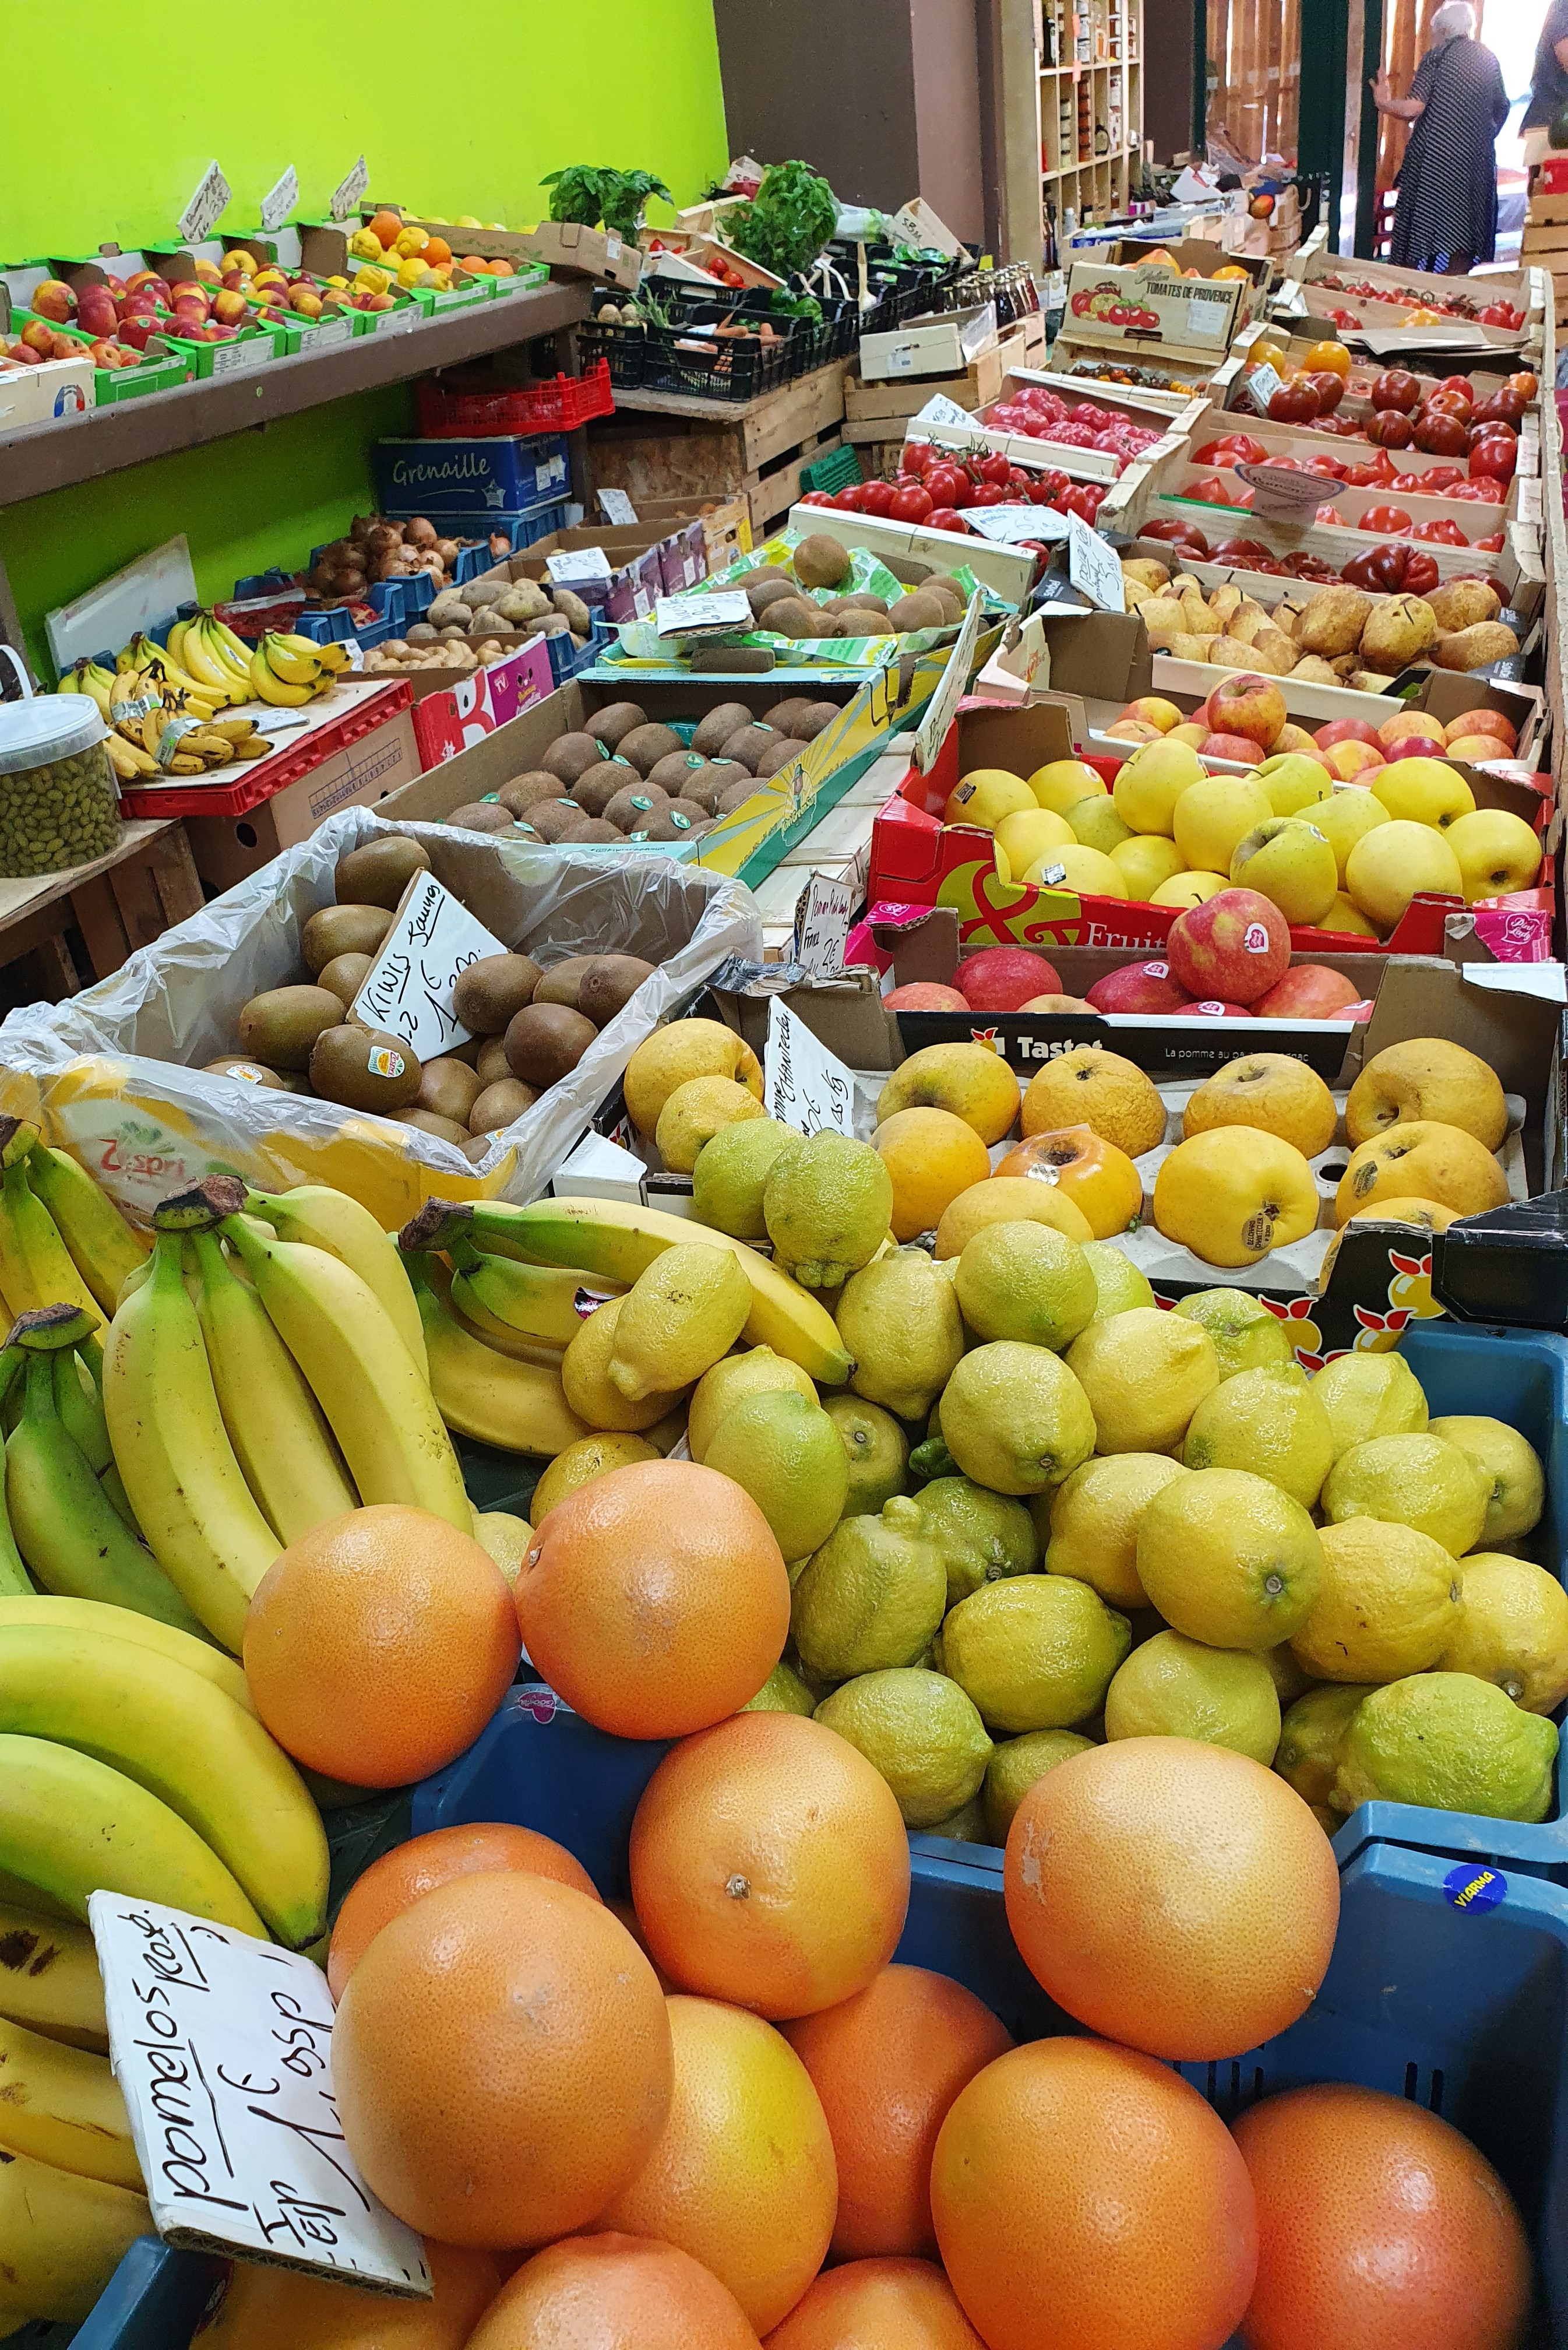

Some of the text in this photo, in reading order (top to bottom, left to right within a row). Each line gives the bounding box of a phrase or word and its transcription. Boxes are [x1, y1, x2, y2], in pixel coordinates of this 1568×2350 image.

[1147, 282, 1234, 304] TOMATES DE PROVENCE
[393, 453, 491, 486] Grenaille
[362, 954, 411, 1022] KIWIS
[1165, 1048, 1176, 1057] La
[1454, 1870, 1495, 1908] VIARMA
[132, 1978, 249, 2211] pomelos
